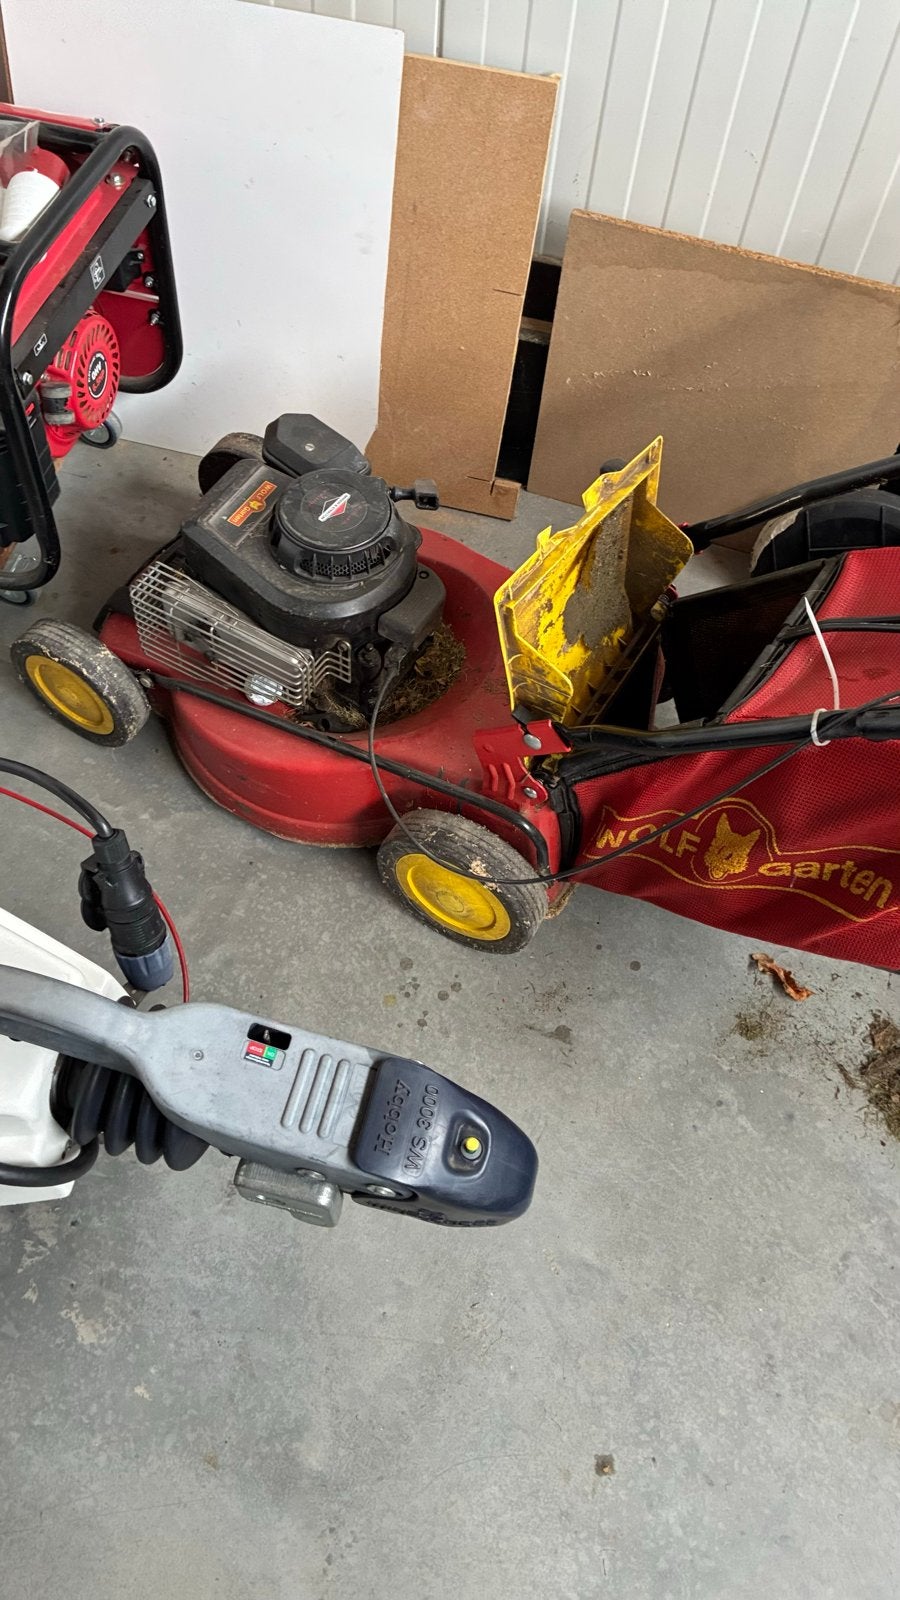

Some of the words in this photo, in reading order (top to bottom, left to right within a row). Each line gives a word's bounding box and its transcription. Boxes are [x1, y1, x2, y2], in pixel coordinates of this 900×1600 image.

[257, 484, 273, 500] WOLF
[233, 506, 251, 523] Garten
[596, 823, 701, 857] WOLF
[374, 1080, 411, 1156] Hobby
[404, 1136, 426, 1169] WS
[416, 1084, 439, 1130] 3000
